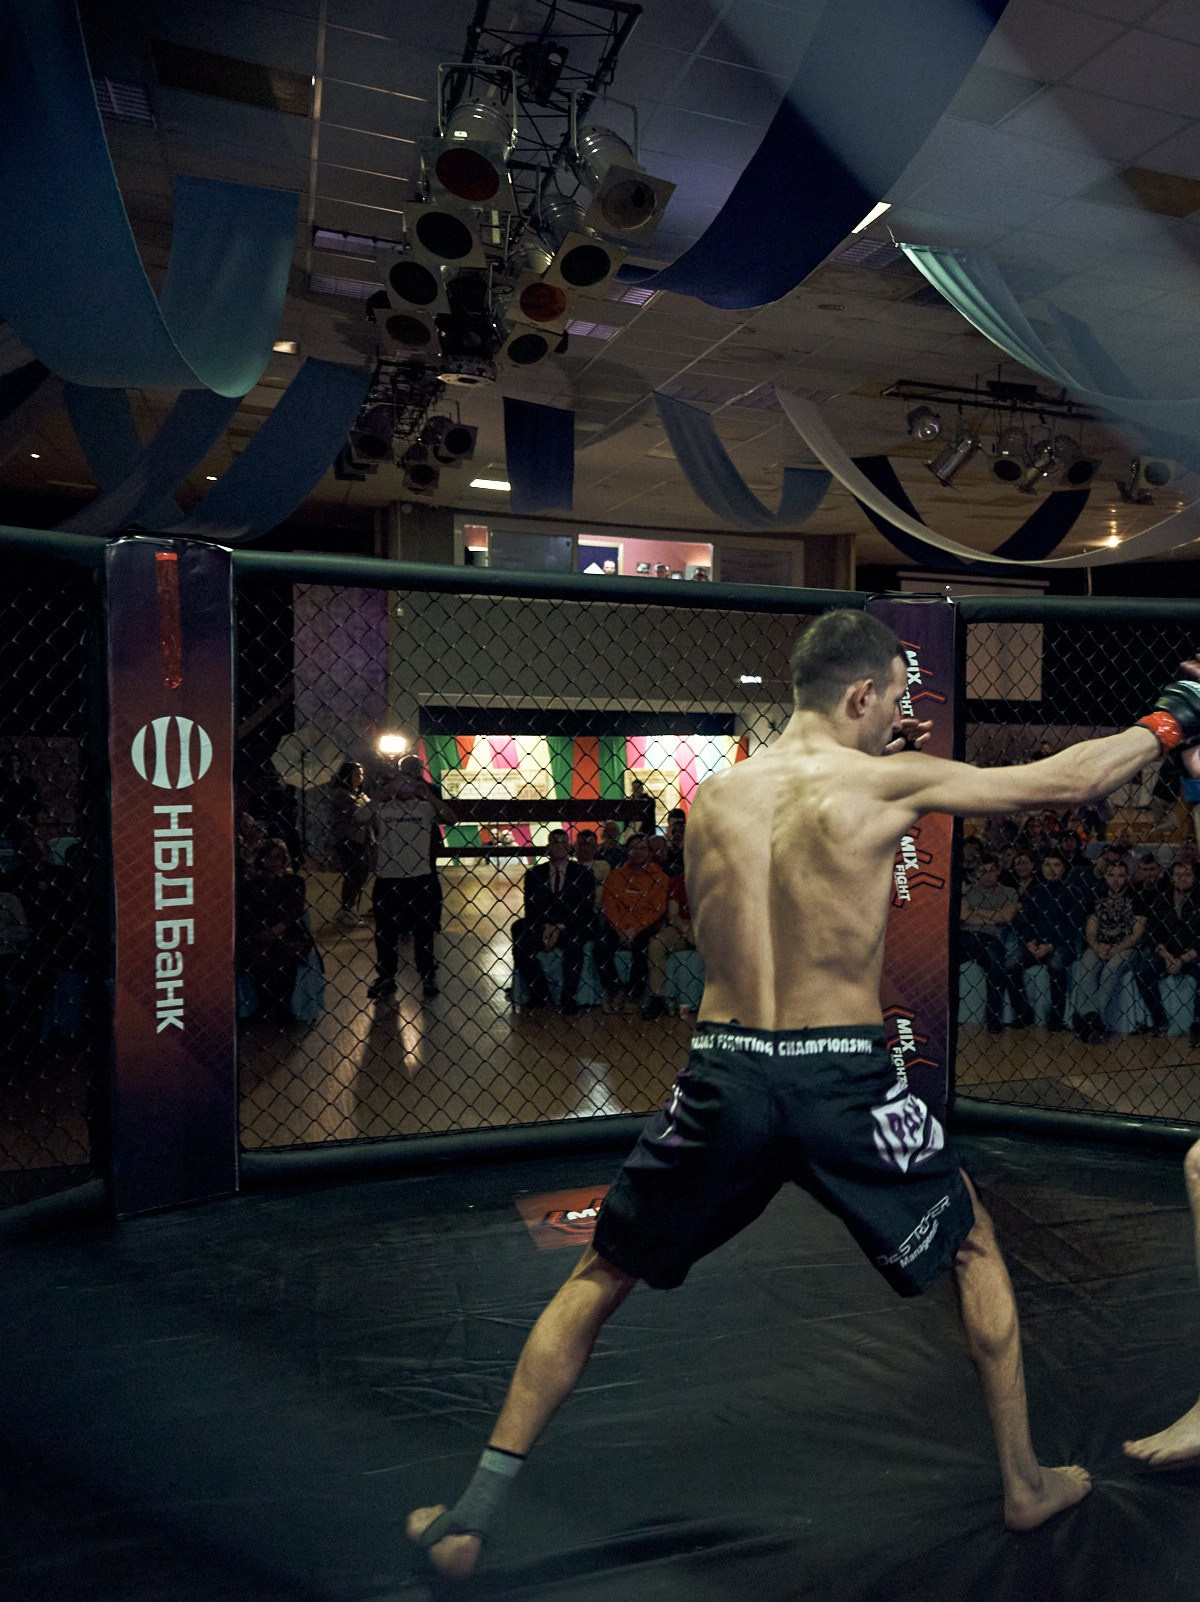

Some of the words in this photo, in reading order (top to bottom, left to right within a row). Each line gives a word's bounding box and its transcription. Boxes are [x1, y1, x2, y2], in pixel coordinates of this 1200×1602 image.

[904, 650, 922, 685] MIX
[153, 804, 195, 911] НБД
[900, 835, 919, 870] MIX
[894, 864, 911, 901] FIGHT
[155, 918, 195, 1034] Банк
[896, 1018, 917, 1053] MIX
